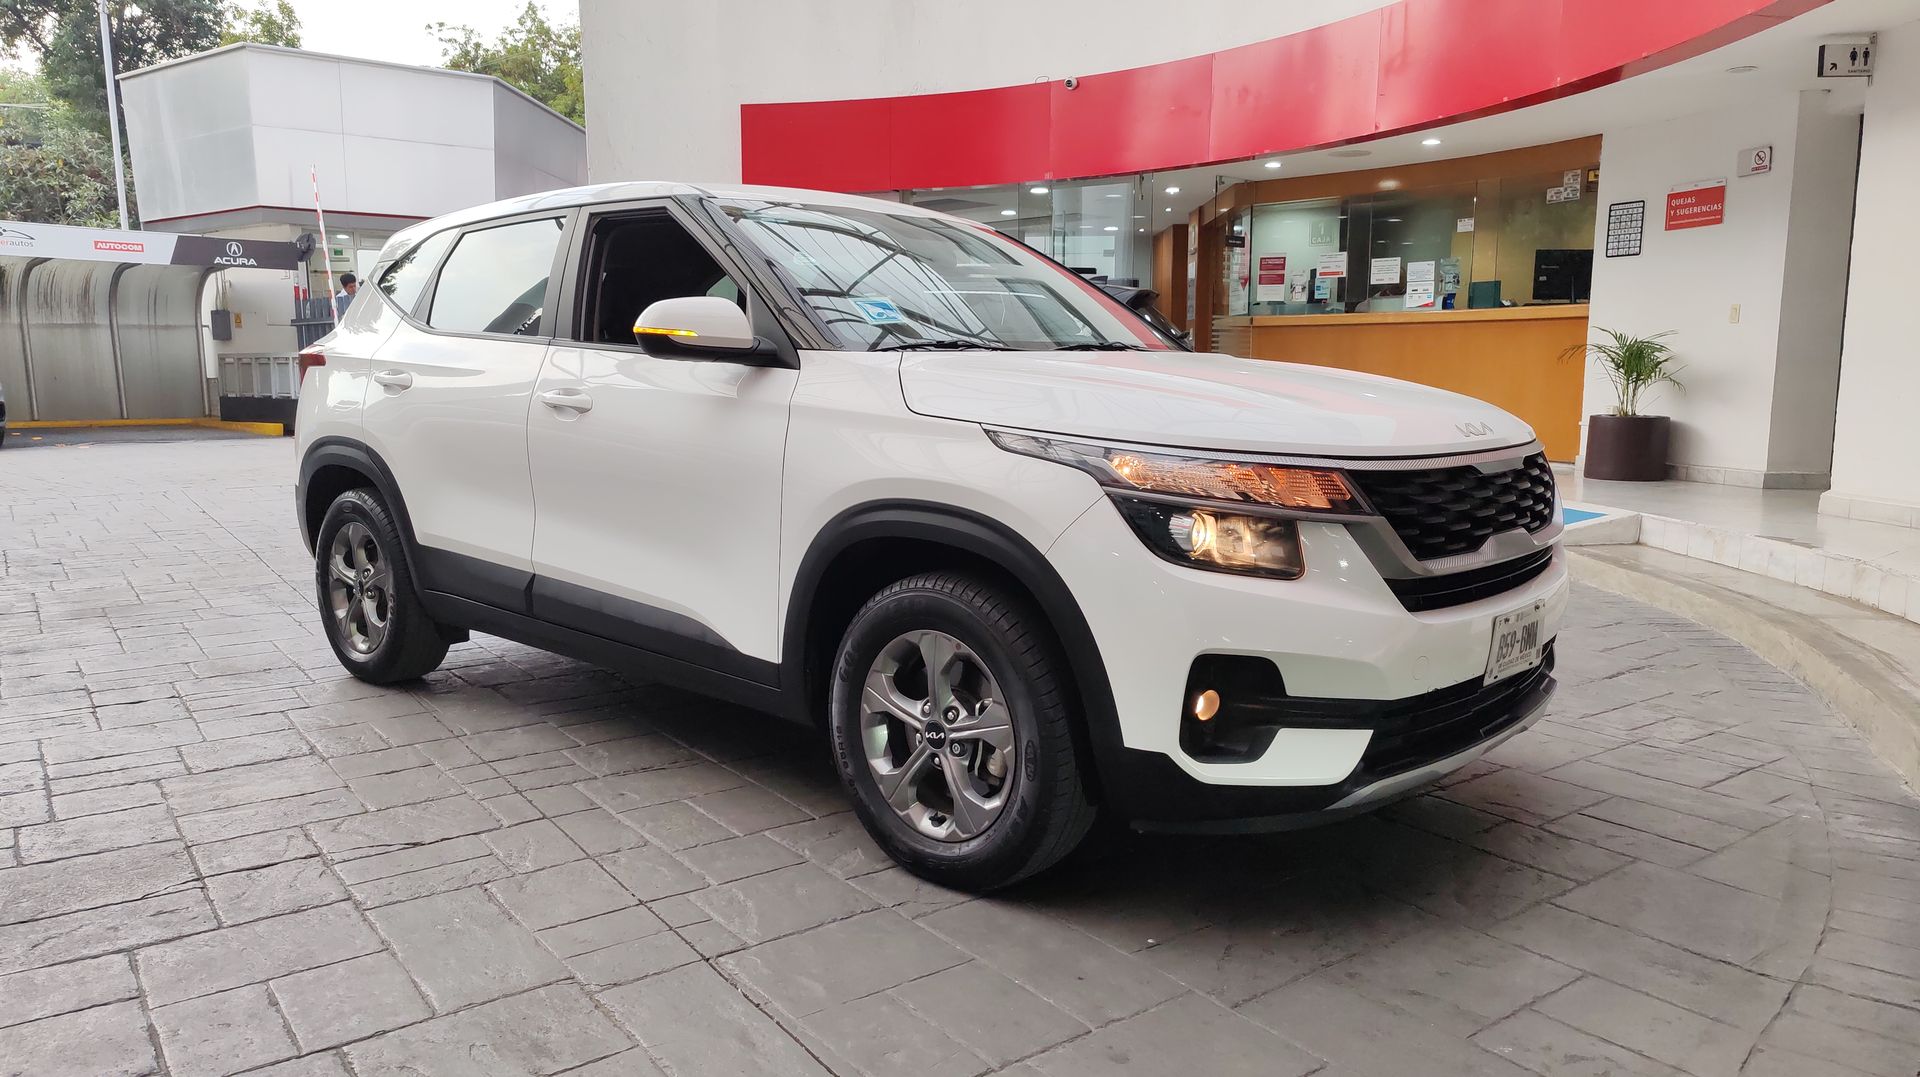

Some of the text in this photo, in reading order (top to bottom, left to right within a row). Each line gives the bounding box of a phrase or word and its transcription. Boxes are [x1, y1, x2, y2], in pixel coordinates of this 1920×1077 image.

[1671, 196, 1696, 207] QUEJAS
[1670, 202, 1722, 217] Y SUGERENCIAS
[1312, 236, 1331, 244] CAJA
[96, 242, 143, 251] AUTOCOM
[214, 256, 258, 266] ACURA
[925, 731, 945, 739] KIA
